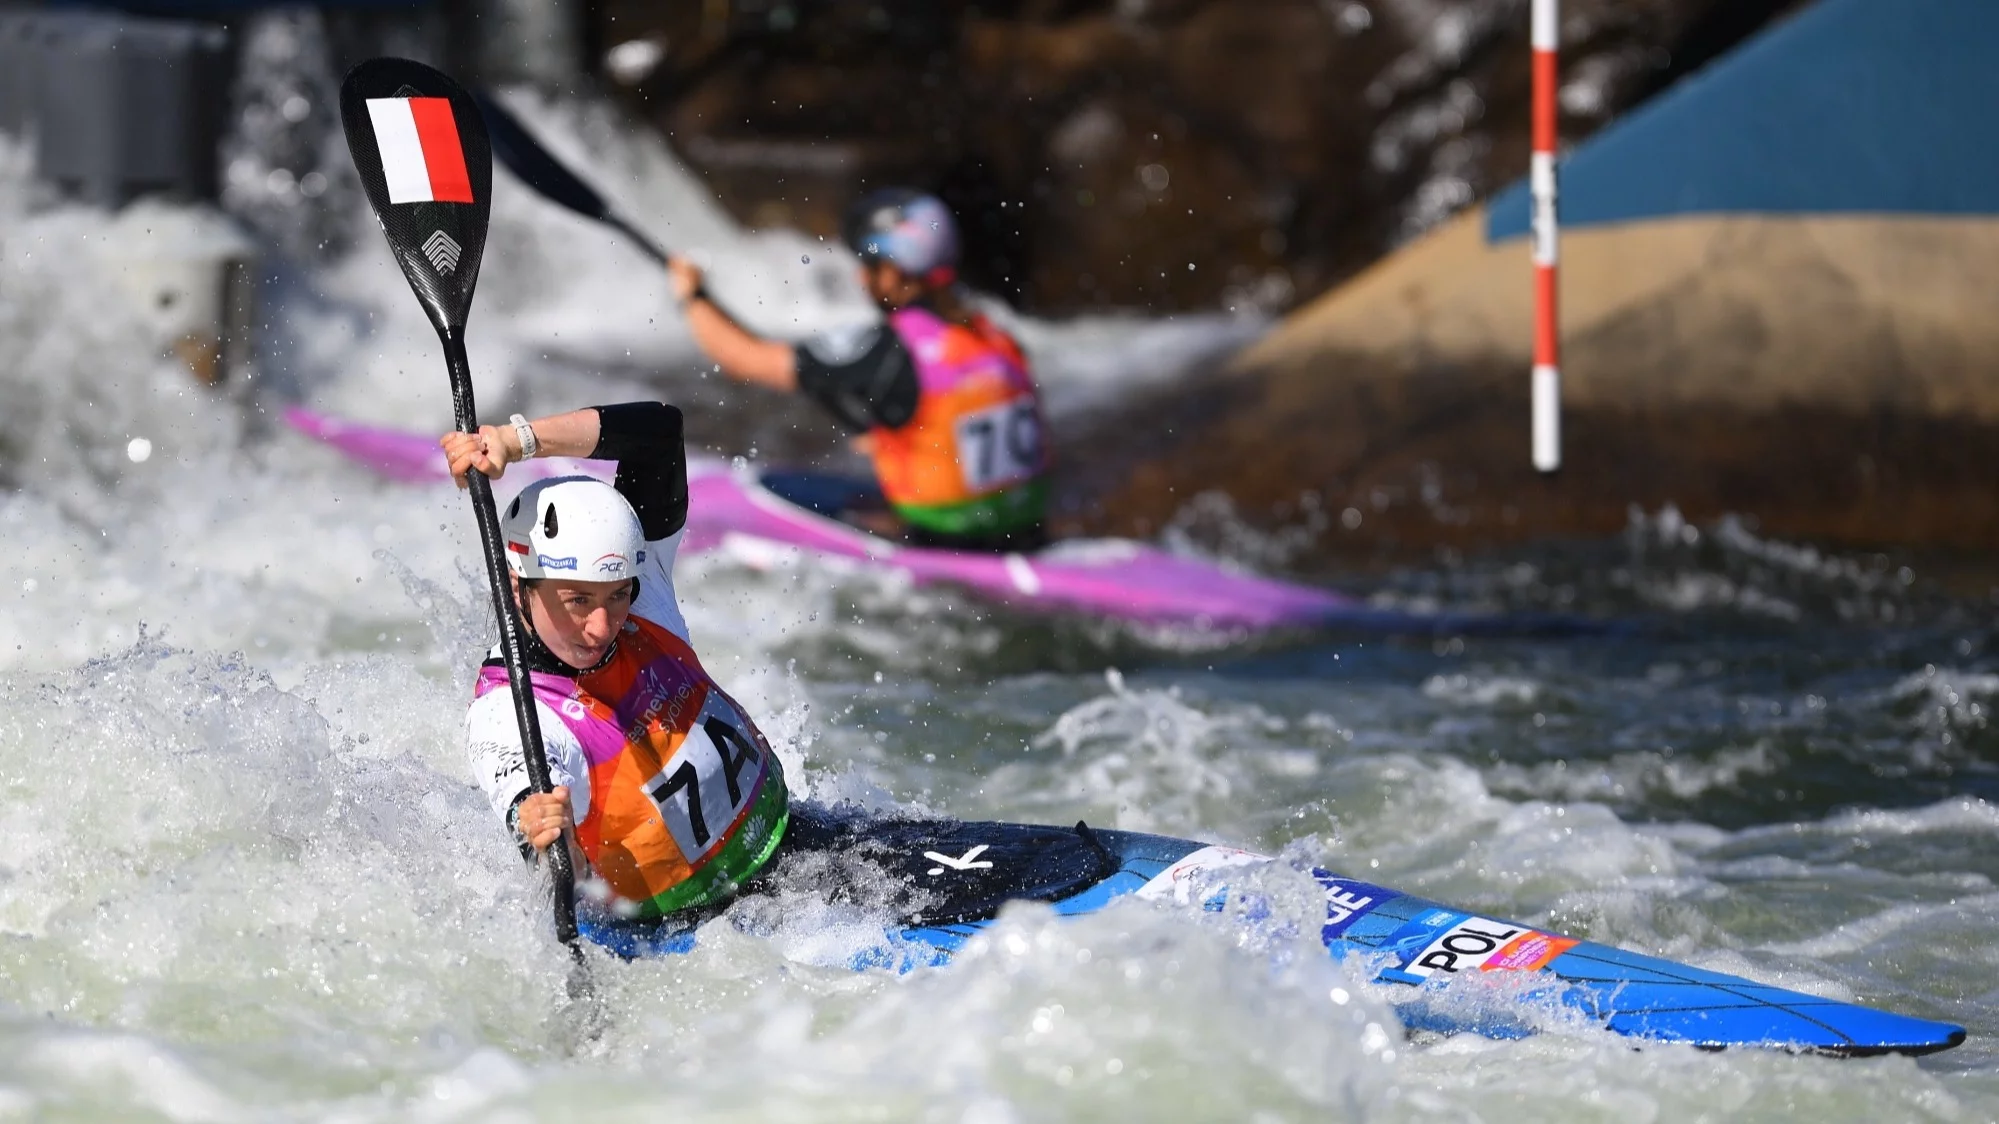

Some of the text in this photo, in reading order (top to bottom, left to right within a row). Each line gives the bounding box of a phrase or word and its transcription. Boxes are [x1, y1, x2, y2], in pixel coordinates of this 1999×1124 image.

[600, 562, 623, 572] PGE
[643, 683, 669, 721] new
[659, 677, 694, 734] sydney
[652, 716, 760, 848] 7A
[1418, 927, 1519, 973] POL
